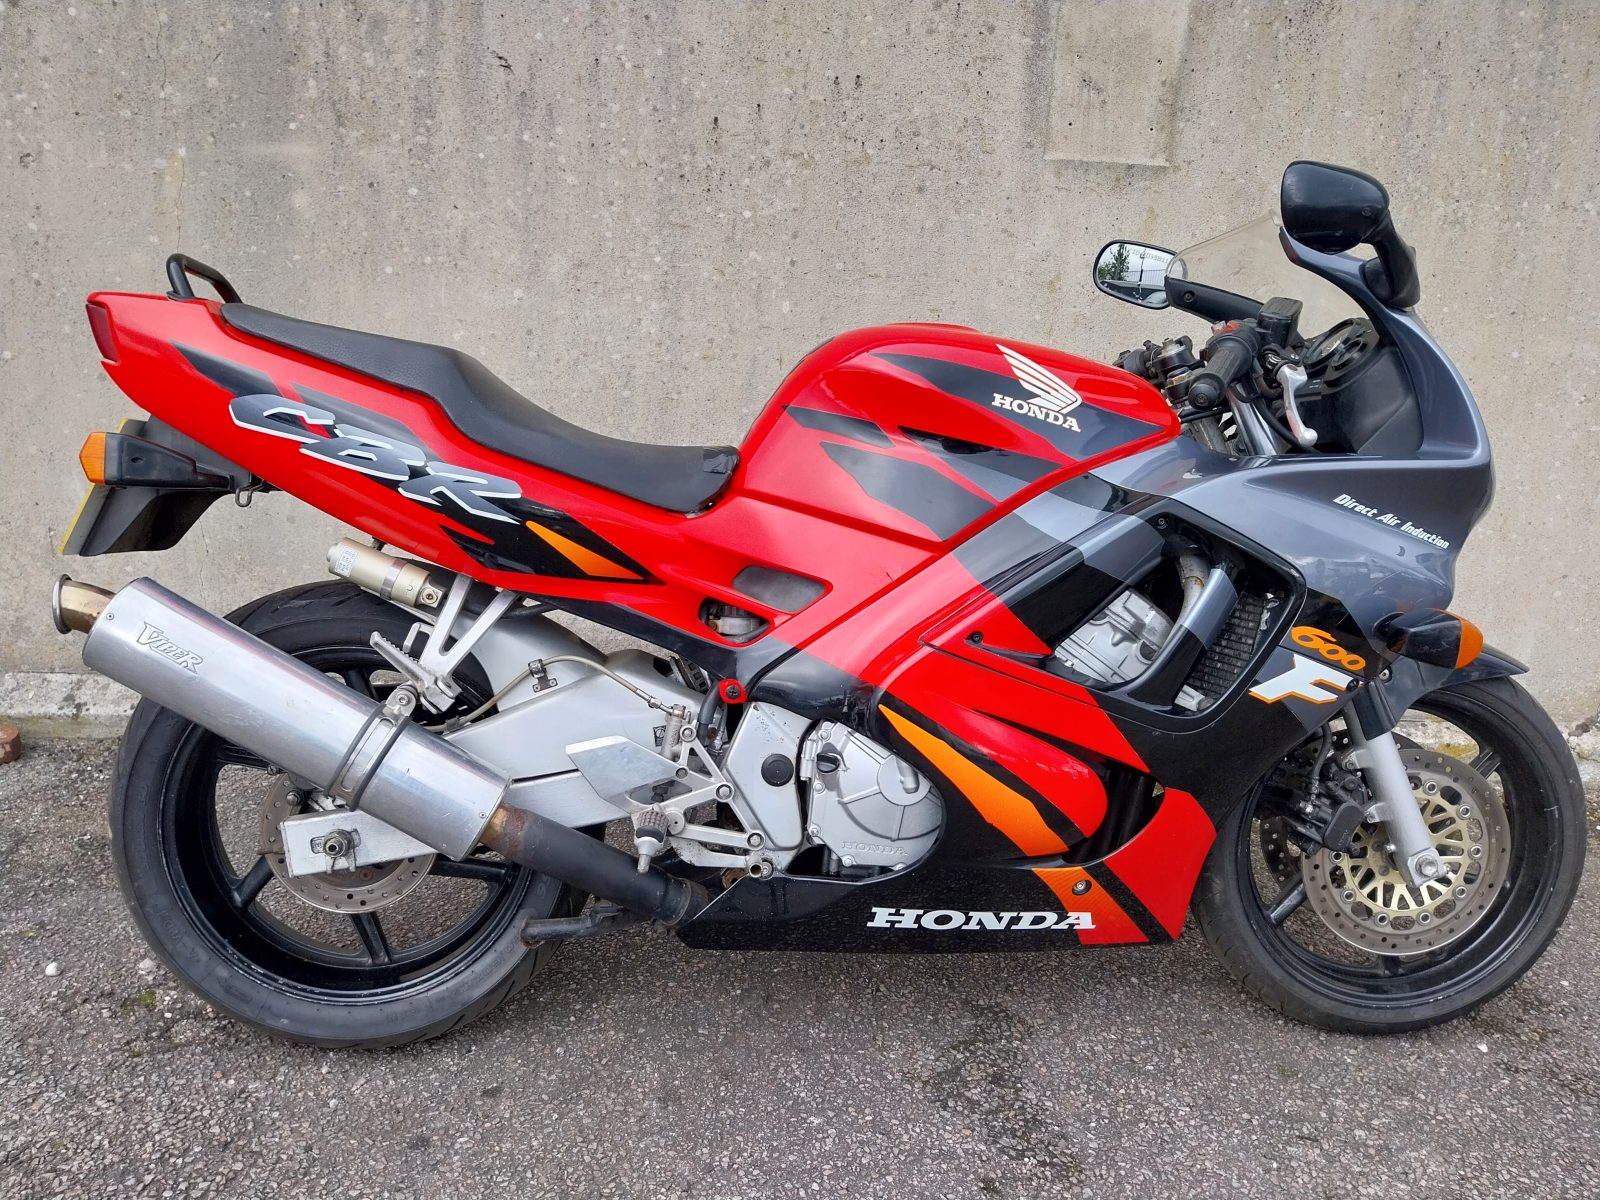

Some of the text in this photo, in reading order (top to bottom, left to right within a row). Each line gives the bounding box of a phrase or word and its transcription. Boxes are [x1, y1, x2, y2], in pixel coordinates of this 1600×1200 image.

[992, 393, 1081, 432] HONDA
[229, 394, 522, 525] CBR
[1333, 494, 1450, 549] Direct Air Induction
[136, 621, 204, 674] VIPER
[1291, 626, 1366, 671] 600
[1248, 653, 1364, 705] F
[842, 842, 909, 856] HONDA
[866, 907, 1096, 930] HONDA
